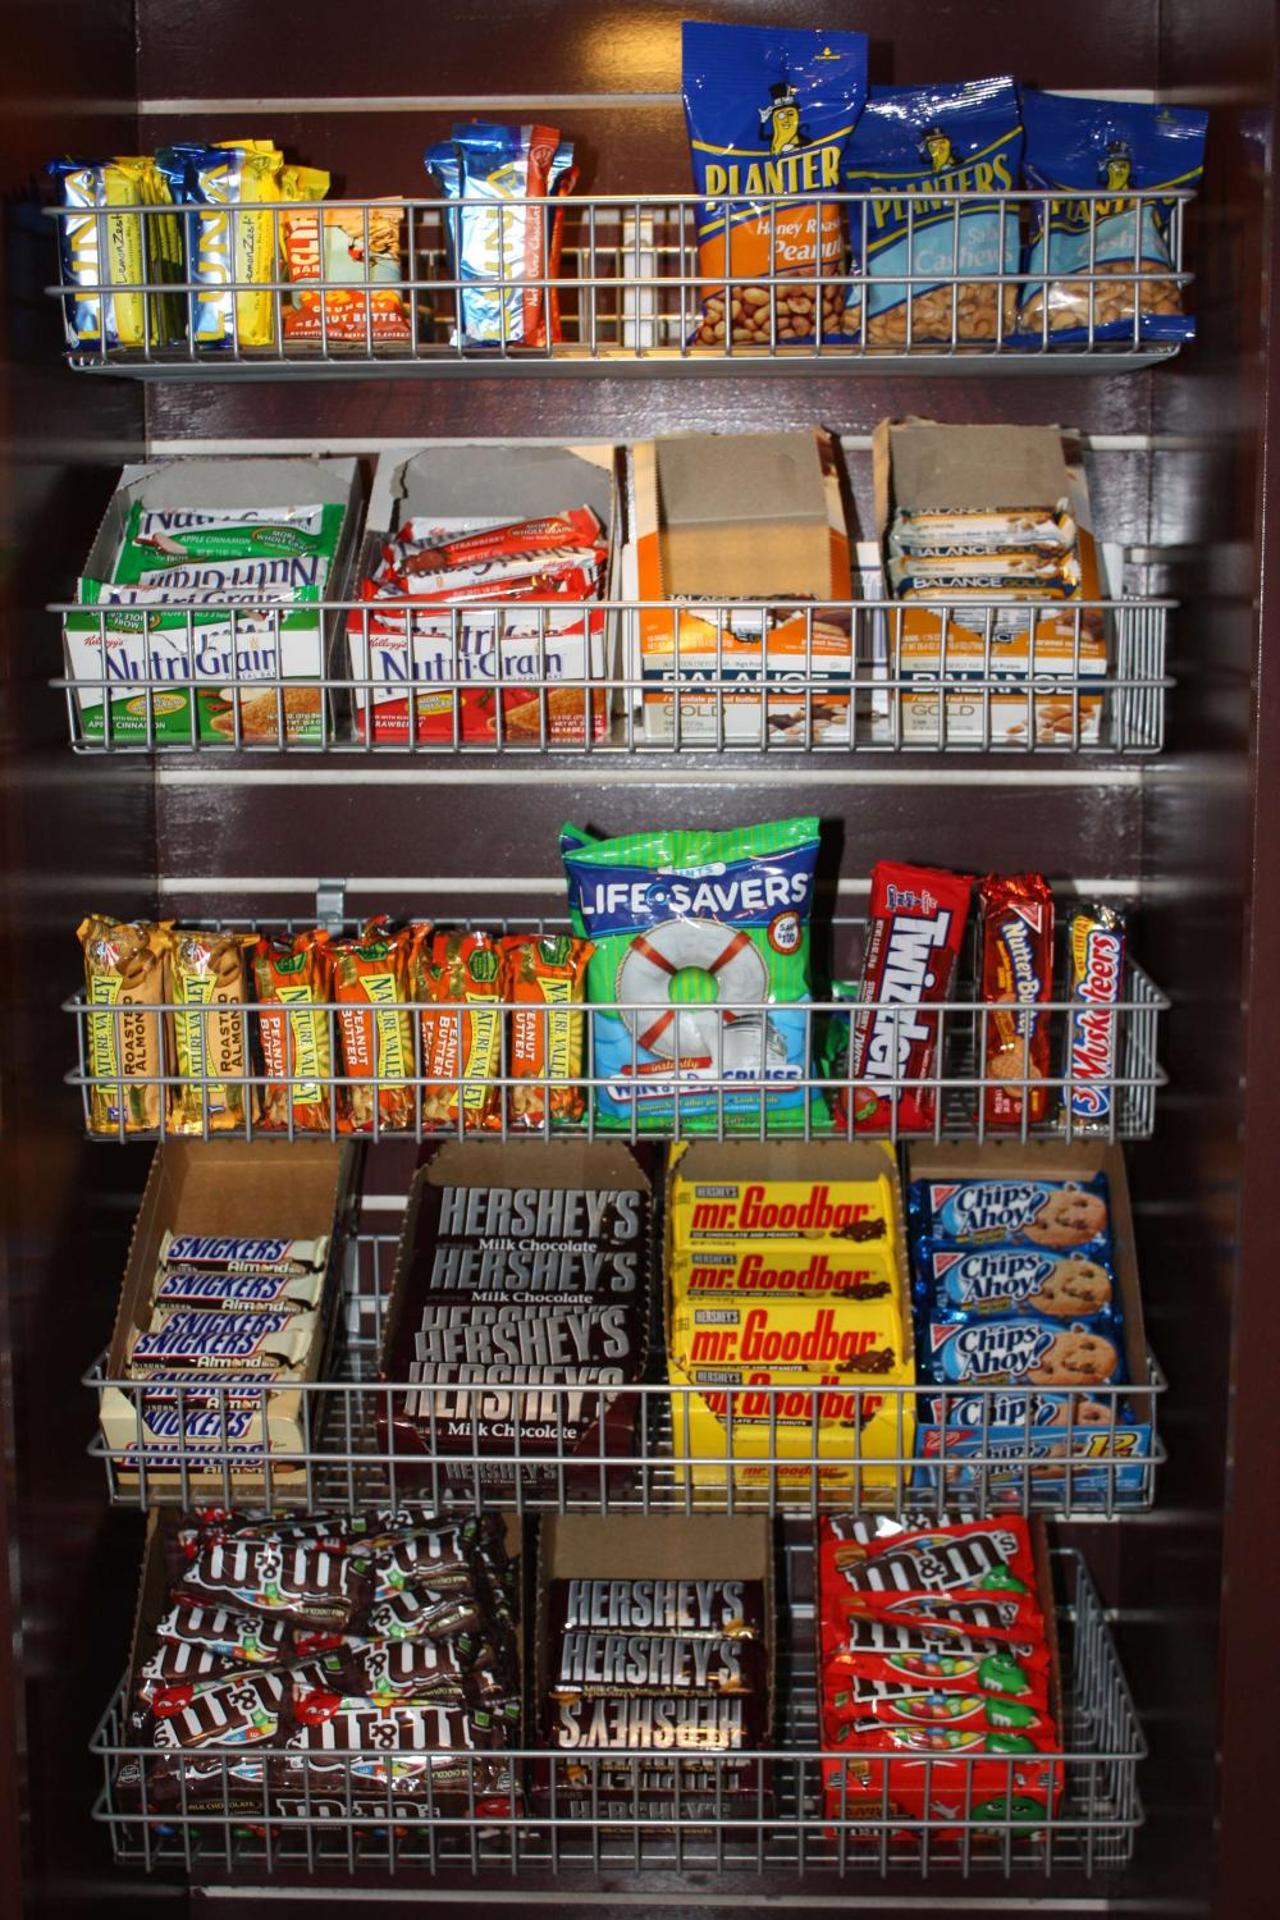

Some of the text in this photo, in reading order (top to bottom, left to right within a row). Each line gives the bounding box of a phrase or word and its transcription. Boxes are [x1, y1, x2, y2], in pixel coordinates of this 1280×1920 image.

[757, 219, 802, 238] Hney
[915, 246, 1013, 273] Cahews
[913, 576, 1002, 588] BALANCE
[116, 721, 167, 729] CINNAON
[579, 873, 808, 915] LIFE SAVERS
[93, 977, 116, 1031] VALEY
[187, 977, 210, 1030] VALEY
[282, 991, 311, 1047] NTURE
[366, 978, 396, 1032] NAURE
[542, 977, 568, 1034] NAURE
[124, 995, 136, 1075] ROASTD
[513, 1009, 526, 1059] UTTER
[523, 1009, 537, 1061] EANUT
[465, 1054, 488, 1106] VALEY
[438, 1187, 641, 1240] HERSHEY'S
[692, 1186, 869, 1230] mr. Goodbar
[956, 1183, 1035, 1212] Chips
[960, 1191, 1047, 1234] Ahoy!
[170, 1237, 290, 1261] SNICKERS
[227, 1261, 289, 1272] Almond
[478, 1238, 598, 1253] Milk Chocolate
[961, 1252, 1042, 1280] Chips
[161, 1276, 284, 1299] SNICKERS
[430, 1249, 638, 1292] HERSHEY'S
[688, 1254, 869, 1290] mr. Goodbar
[963, 1261, 1053, 1303] Ahoy!
[222, 1300, 284, 1311] Almond
[471, 1291, 593, 1304] Milk Chocolate
[163, 1312, 289, 1333] SNICKERS
[414, 1307, 631, 1365] HERSHEY'S
[690, 1309, 876, 1361] mr. Goodbar
[958, 1323, 1040, 1352] Chips
[136, 1333, 258, 1355] SNICKERS
[197, 1356, 262, 1368] Almond
[960, 1333, 1052, 1379] Ahoy!
[698, 1372, 741, 1384] HERSHEY'S
[206, 1398, 262, 1409] Amon
[447, 1422, 489, 1436] Mik
[568, 1579, 744, 1628] HERSHEY'S
[560, 1633, 743, 1687] HERSHEY'S
[558, 1699, 742, 1748] HERSHEY'S
